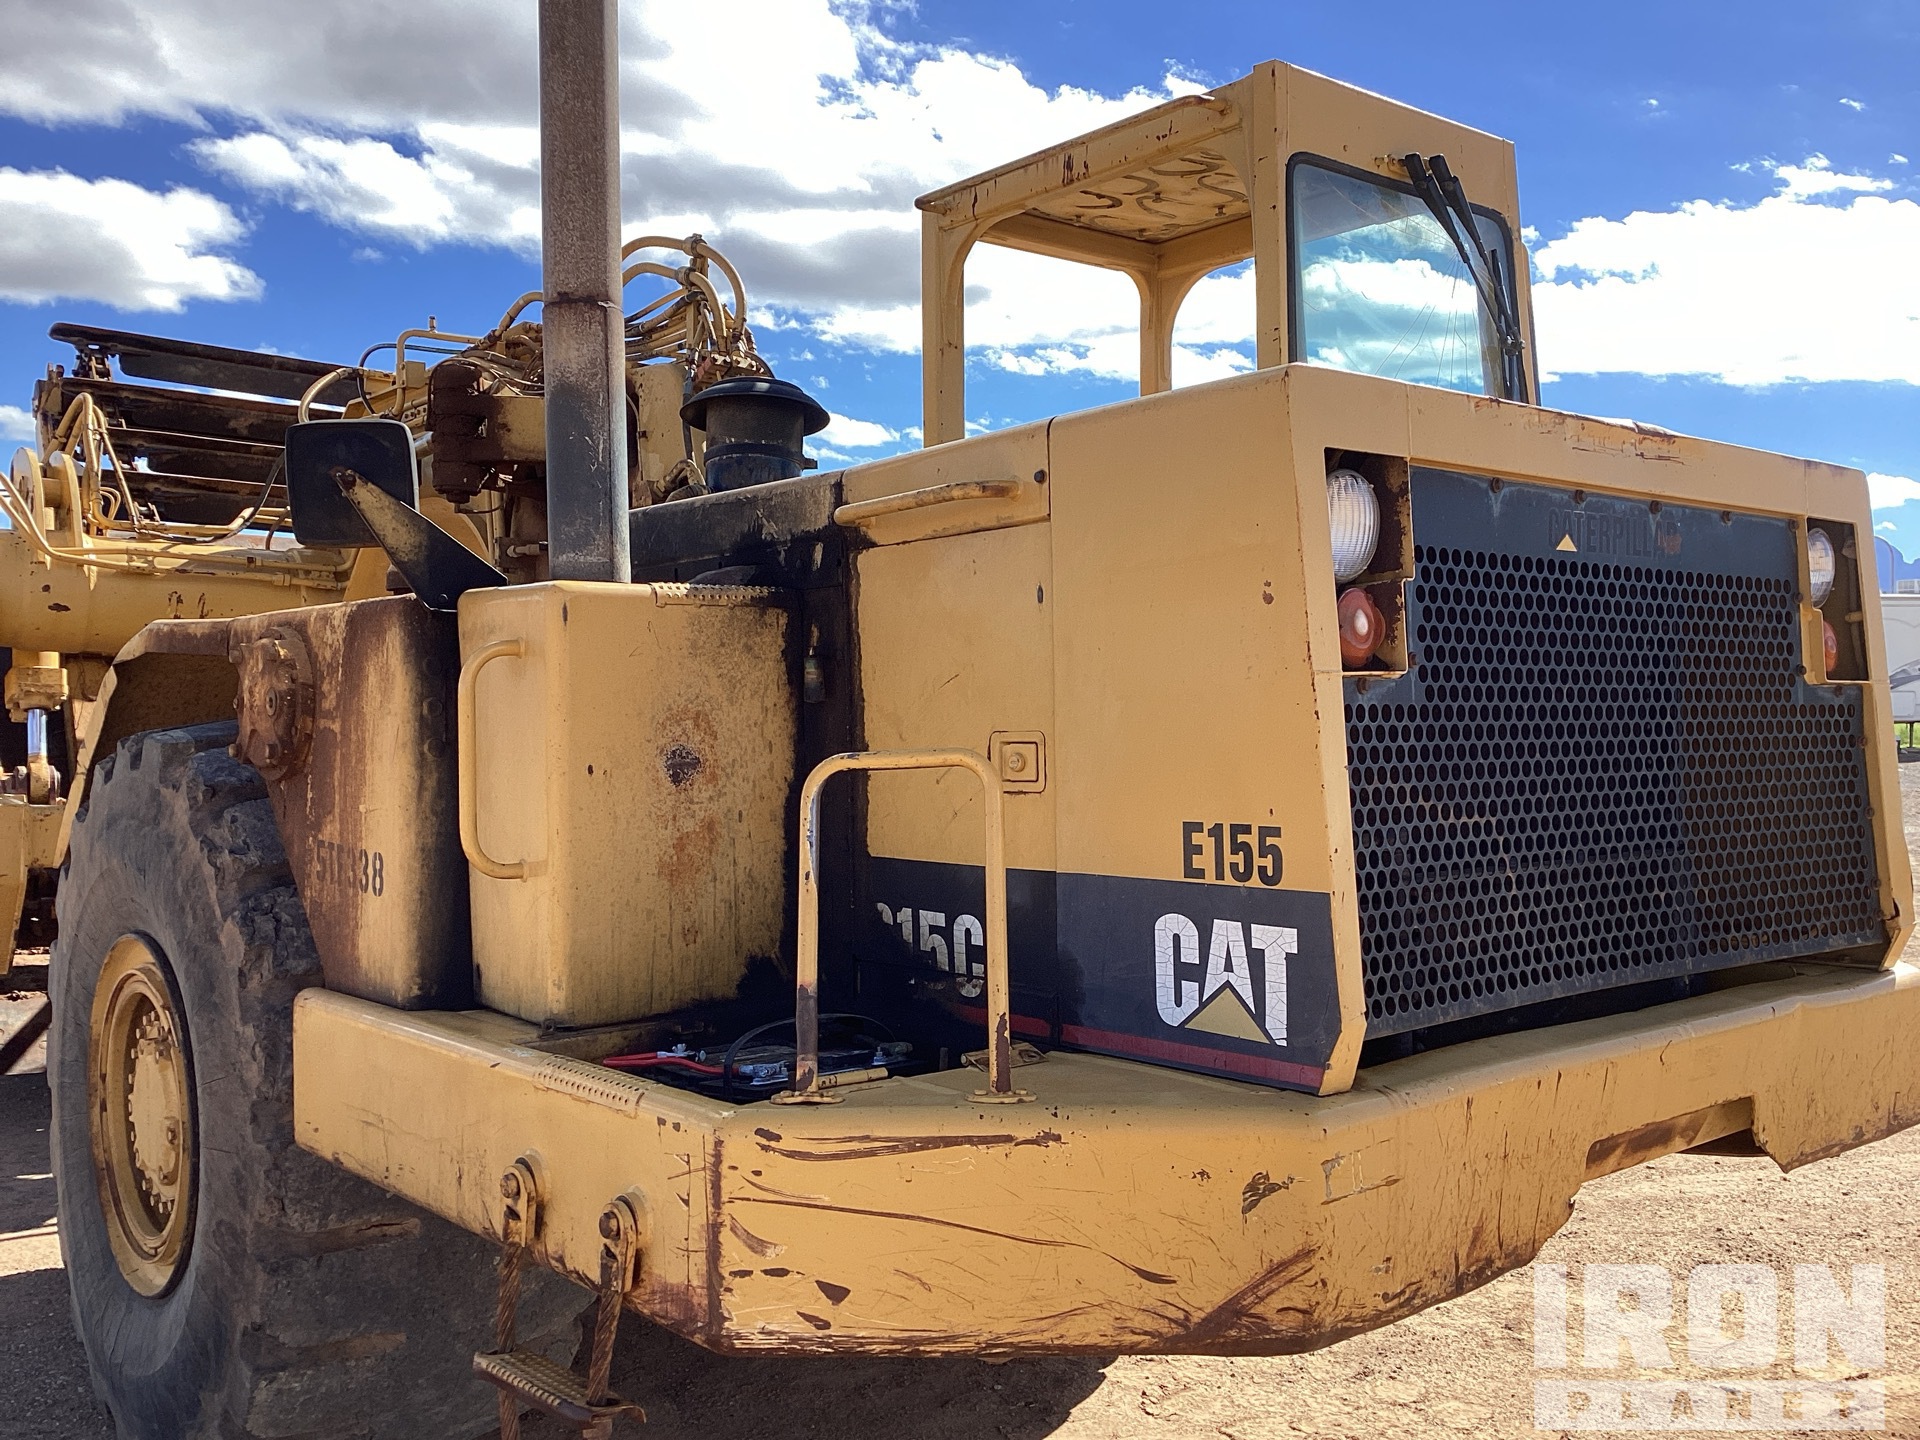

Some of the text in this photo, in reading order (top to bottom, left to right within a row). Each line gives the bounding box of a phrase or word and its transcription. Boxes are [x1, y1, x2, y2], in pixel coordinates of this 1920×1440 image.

[1182, 821, 1283, 887] E155
[876, 902, 985, 998] 15C
[1154, 913, 1298, 1047] CAT
